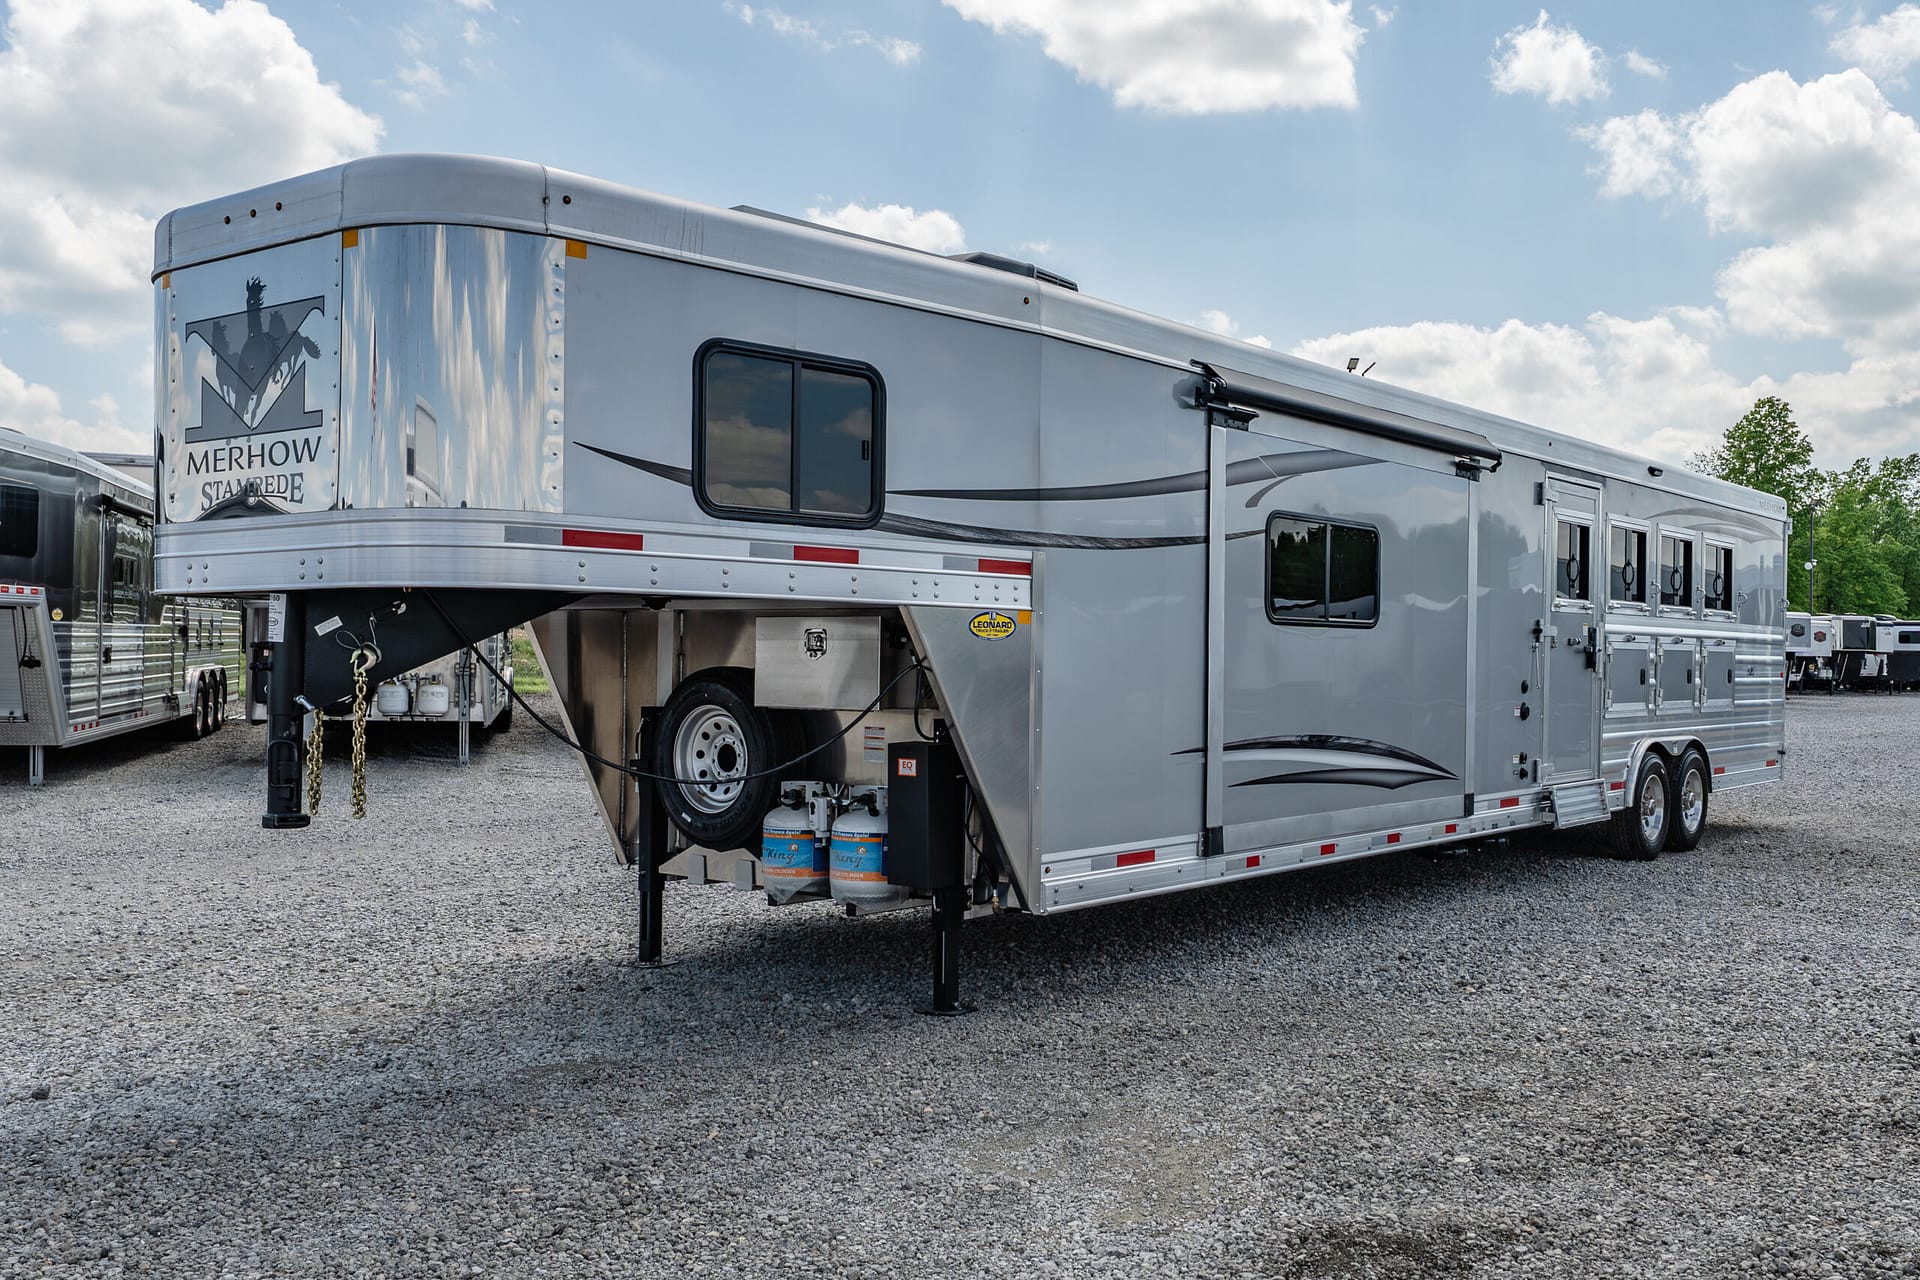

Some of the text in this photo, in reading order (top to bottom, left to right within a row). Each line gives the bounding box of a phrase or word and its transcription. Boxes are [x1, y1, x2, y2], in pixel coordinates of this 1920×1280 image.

[187, 435, 322, 476] MERHOW
[973, 620, 1012, 628] LEONARD
[902, 761, 913, 770] EQ
